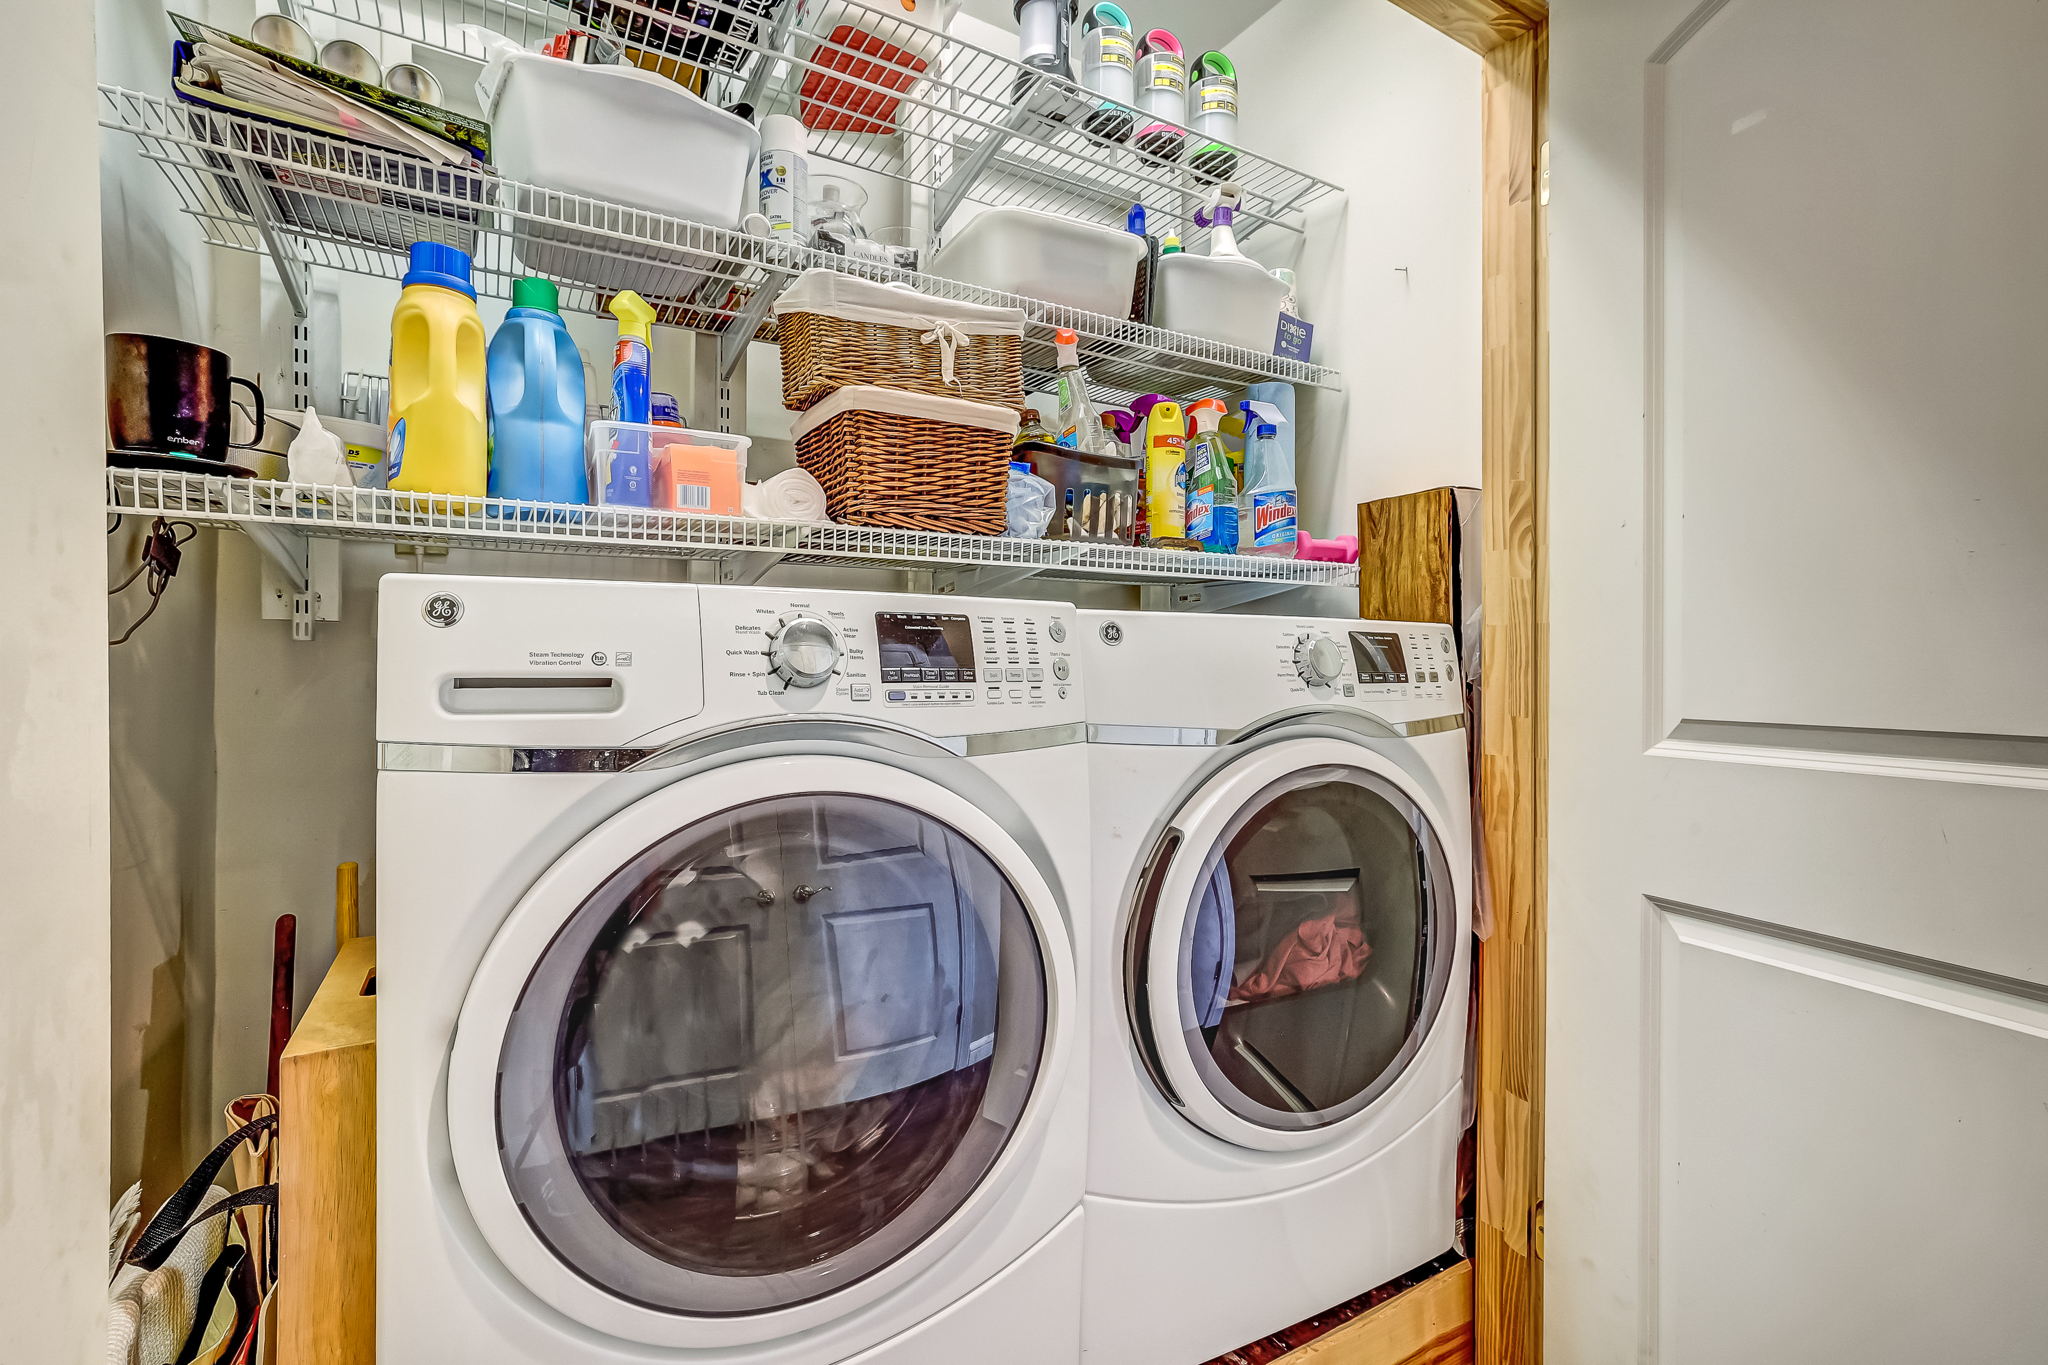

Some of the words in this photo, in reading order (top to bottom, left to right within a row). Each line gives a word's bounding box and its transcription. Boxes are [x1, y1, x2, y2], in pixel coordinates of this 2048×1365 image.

[853, 251, 889, 263] CANDLES
[1292, 336, 1302, 345] go
[167, 436, 200, 445] ember
[1256, 503, 1296, 531] Windex
